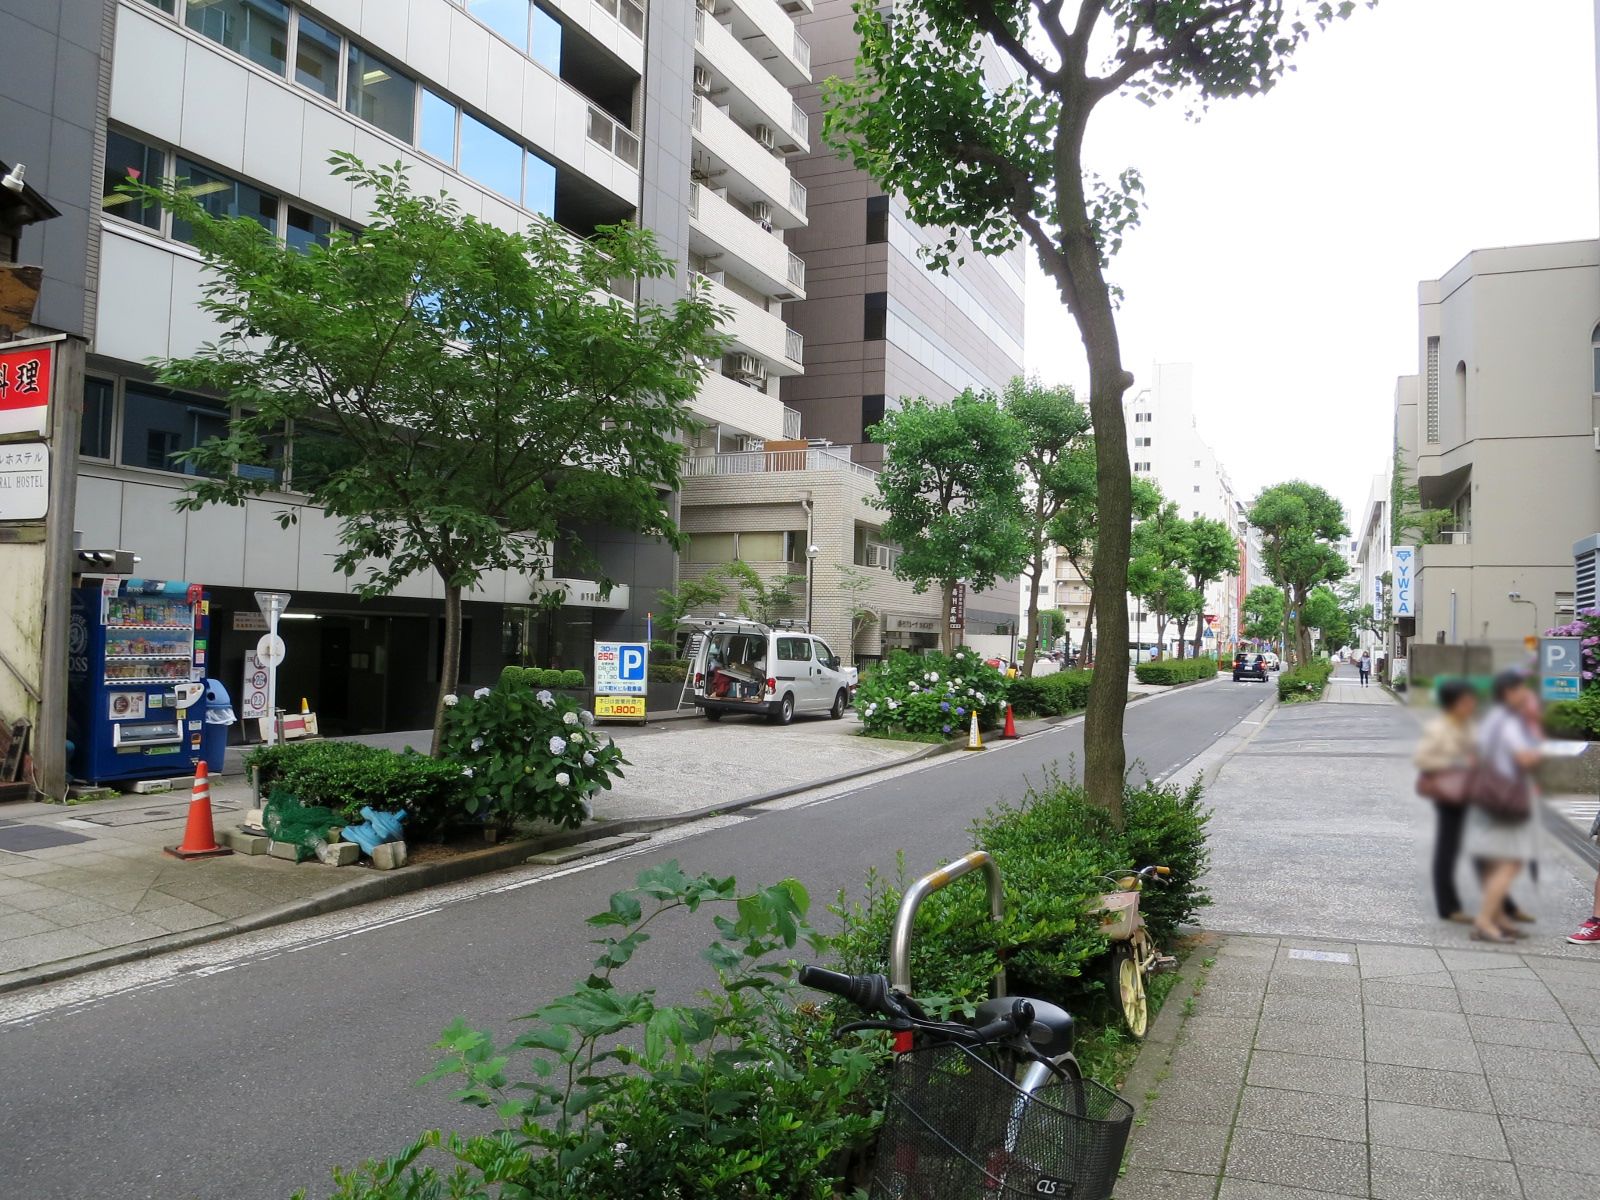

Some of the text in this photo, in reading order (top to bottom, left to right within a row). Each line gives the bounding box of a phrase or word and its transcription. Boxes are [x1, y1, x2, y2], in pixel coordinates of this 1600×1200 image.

[16, 475, 44, 488] HOSTEL
[1396, 566, 1410, 613] YWCA
[623, 649, 642, 678] P
[1547, 645, 1566, 668] P
